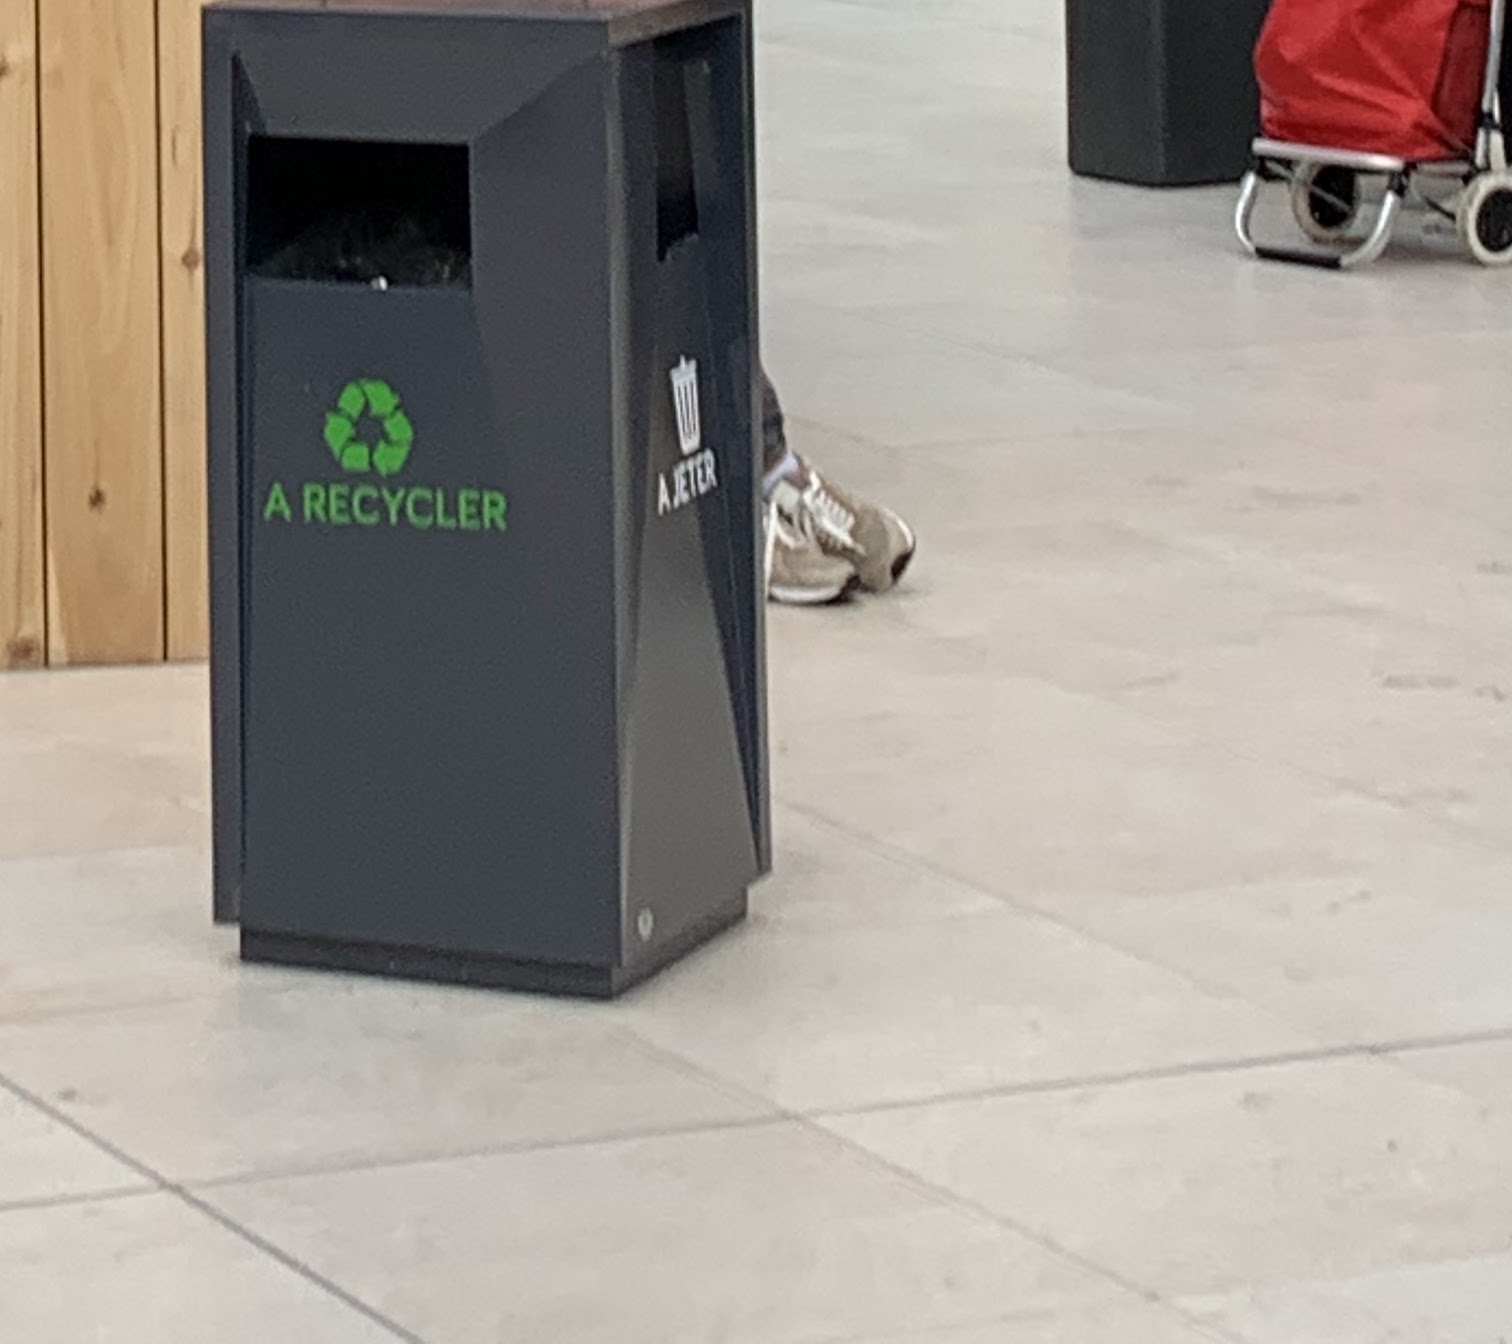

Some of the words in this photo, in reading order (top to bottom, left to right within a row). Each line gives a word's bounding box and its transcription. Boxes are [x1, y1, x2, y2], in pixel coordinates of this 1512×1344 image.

[263, 481, 291, 522] A
[302, 483, 508, 531] RECYCLER
[657, 472, 671, 516] A
[673, 447, 718, 509] JETER
